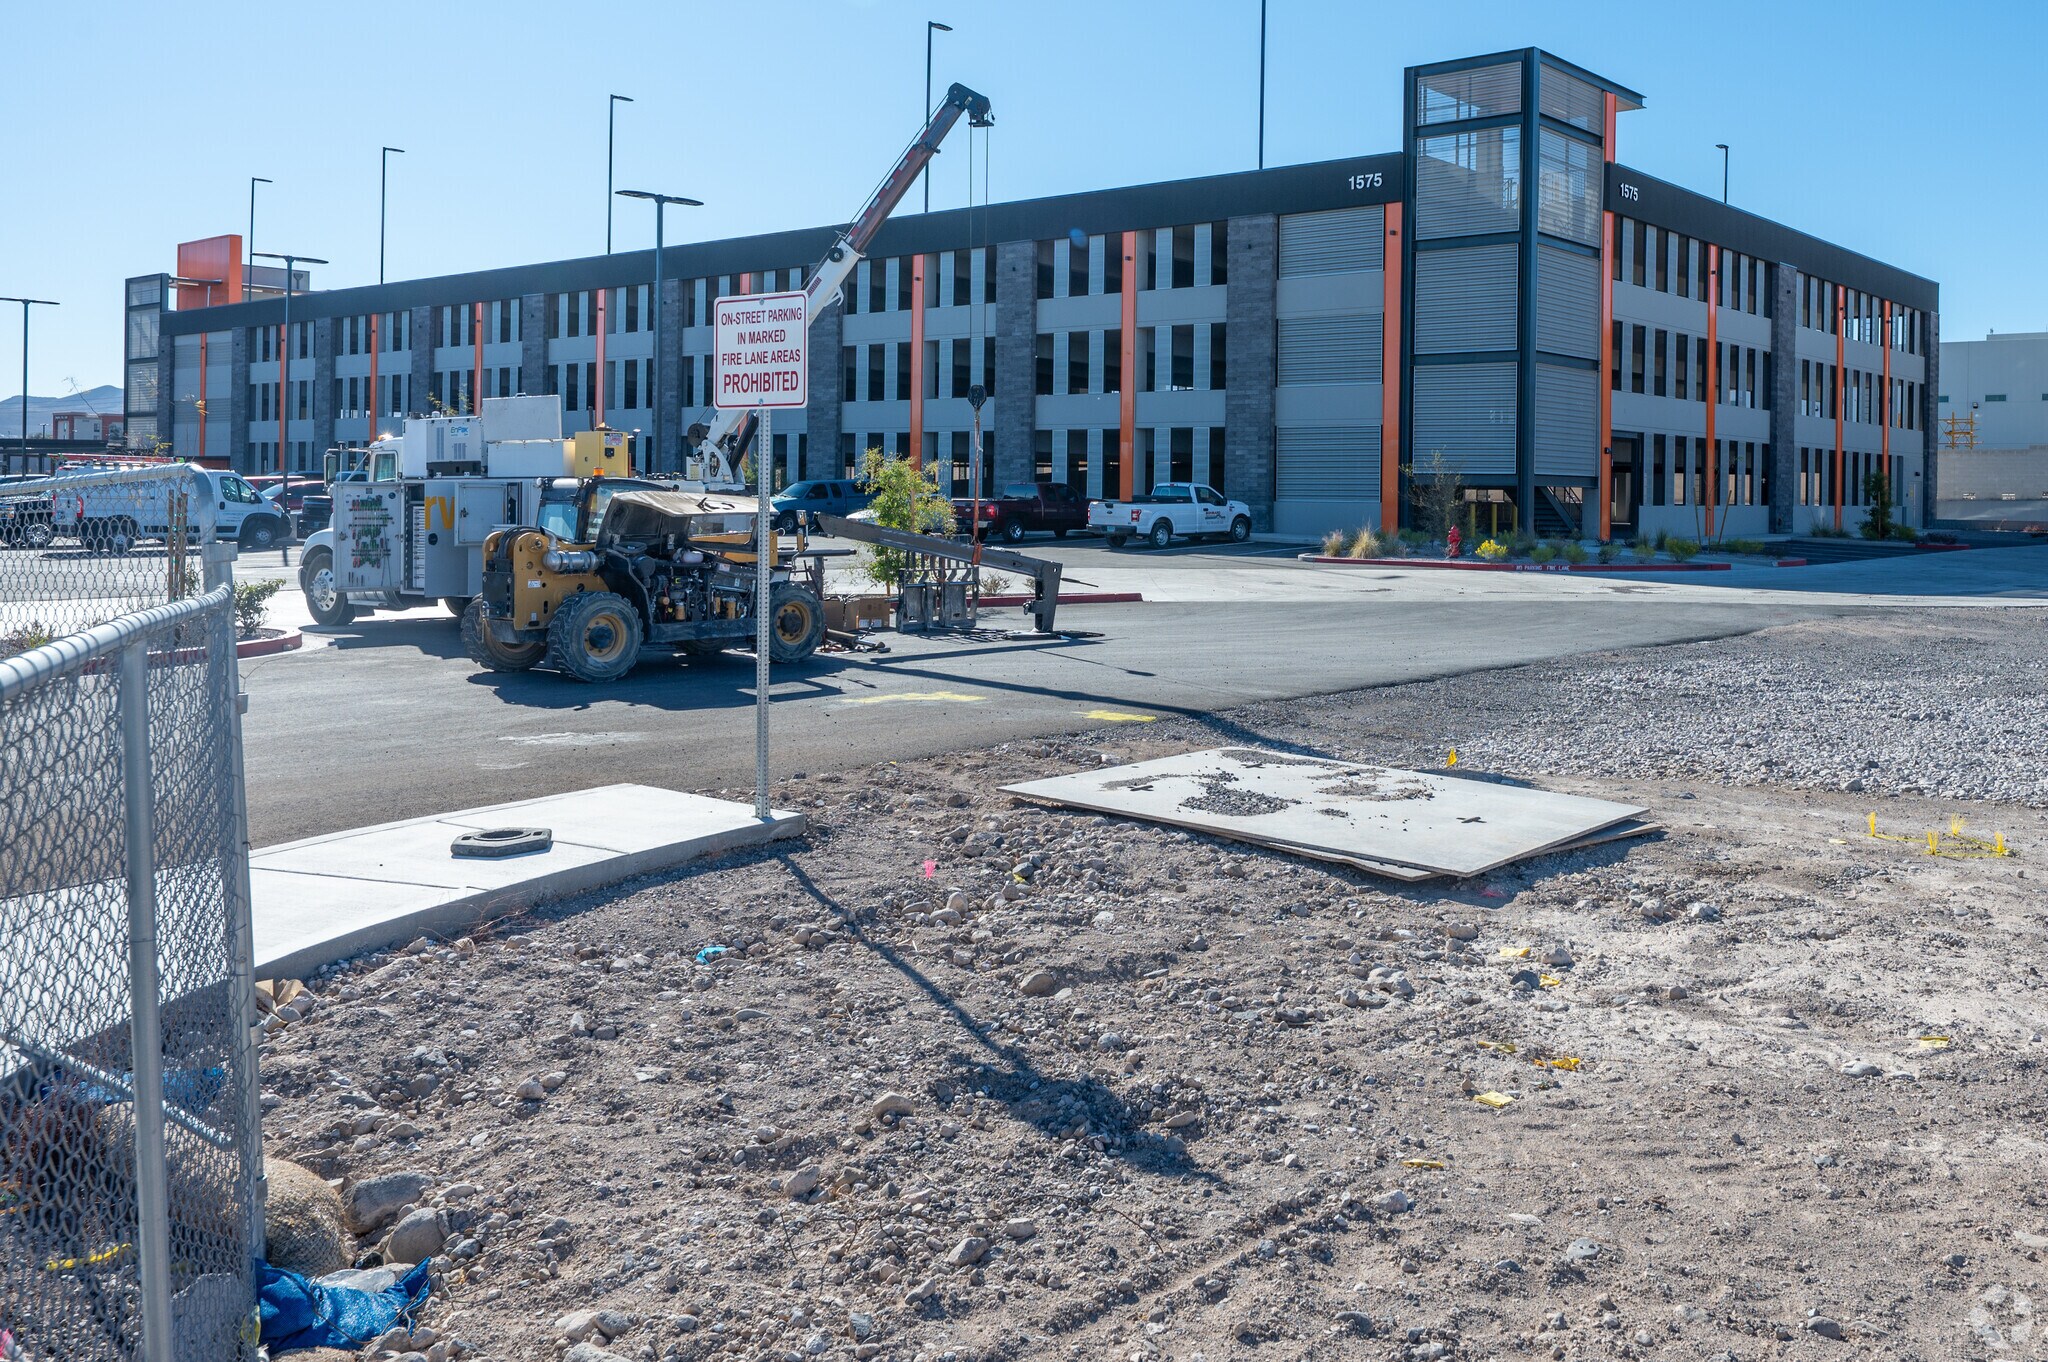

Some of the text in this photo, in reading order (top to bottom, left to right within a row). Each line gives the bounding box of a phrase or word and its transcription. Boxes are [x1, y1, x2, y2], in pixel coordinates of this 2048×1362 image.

[1349, 172, 1383, 190] 1575
[1620, 182, 1639, 201] 1575
[721, 307, 802, 326] ON-STREET PARKING
[737, 329, 786, 345] IN MARKED
[722, 349, 801, 366] FIRE LANE AREAS
[723, 370, 799, 394] PROHIBITED
